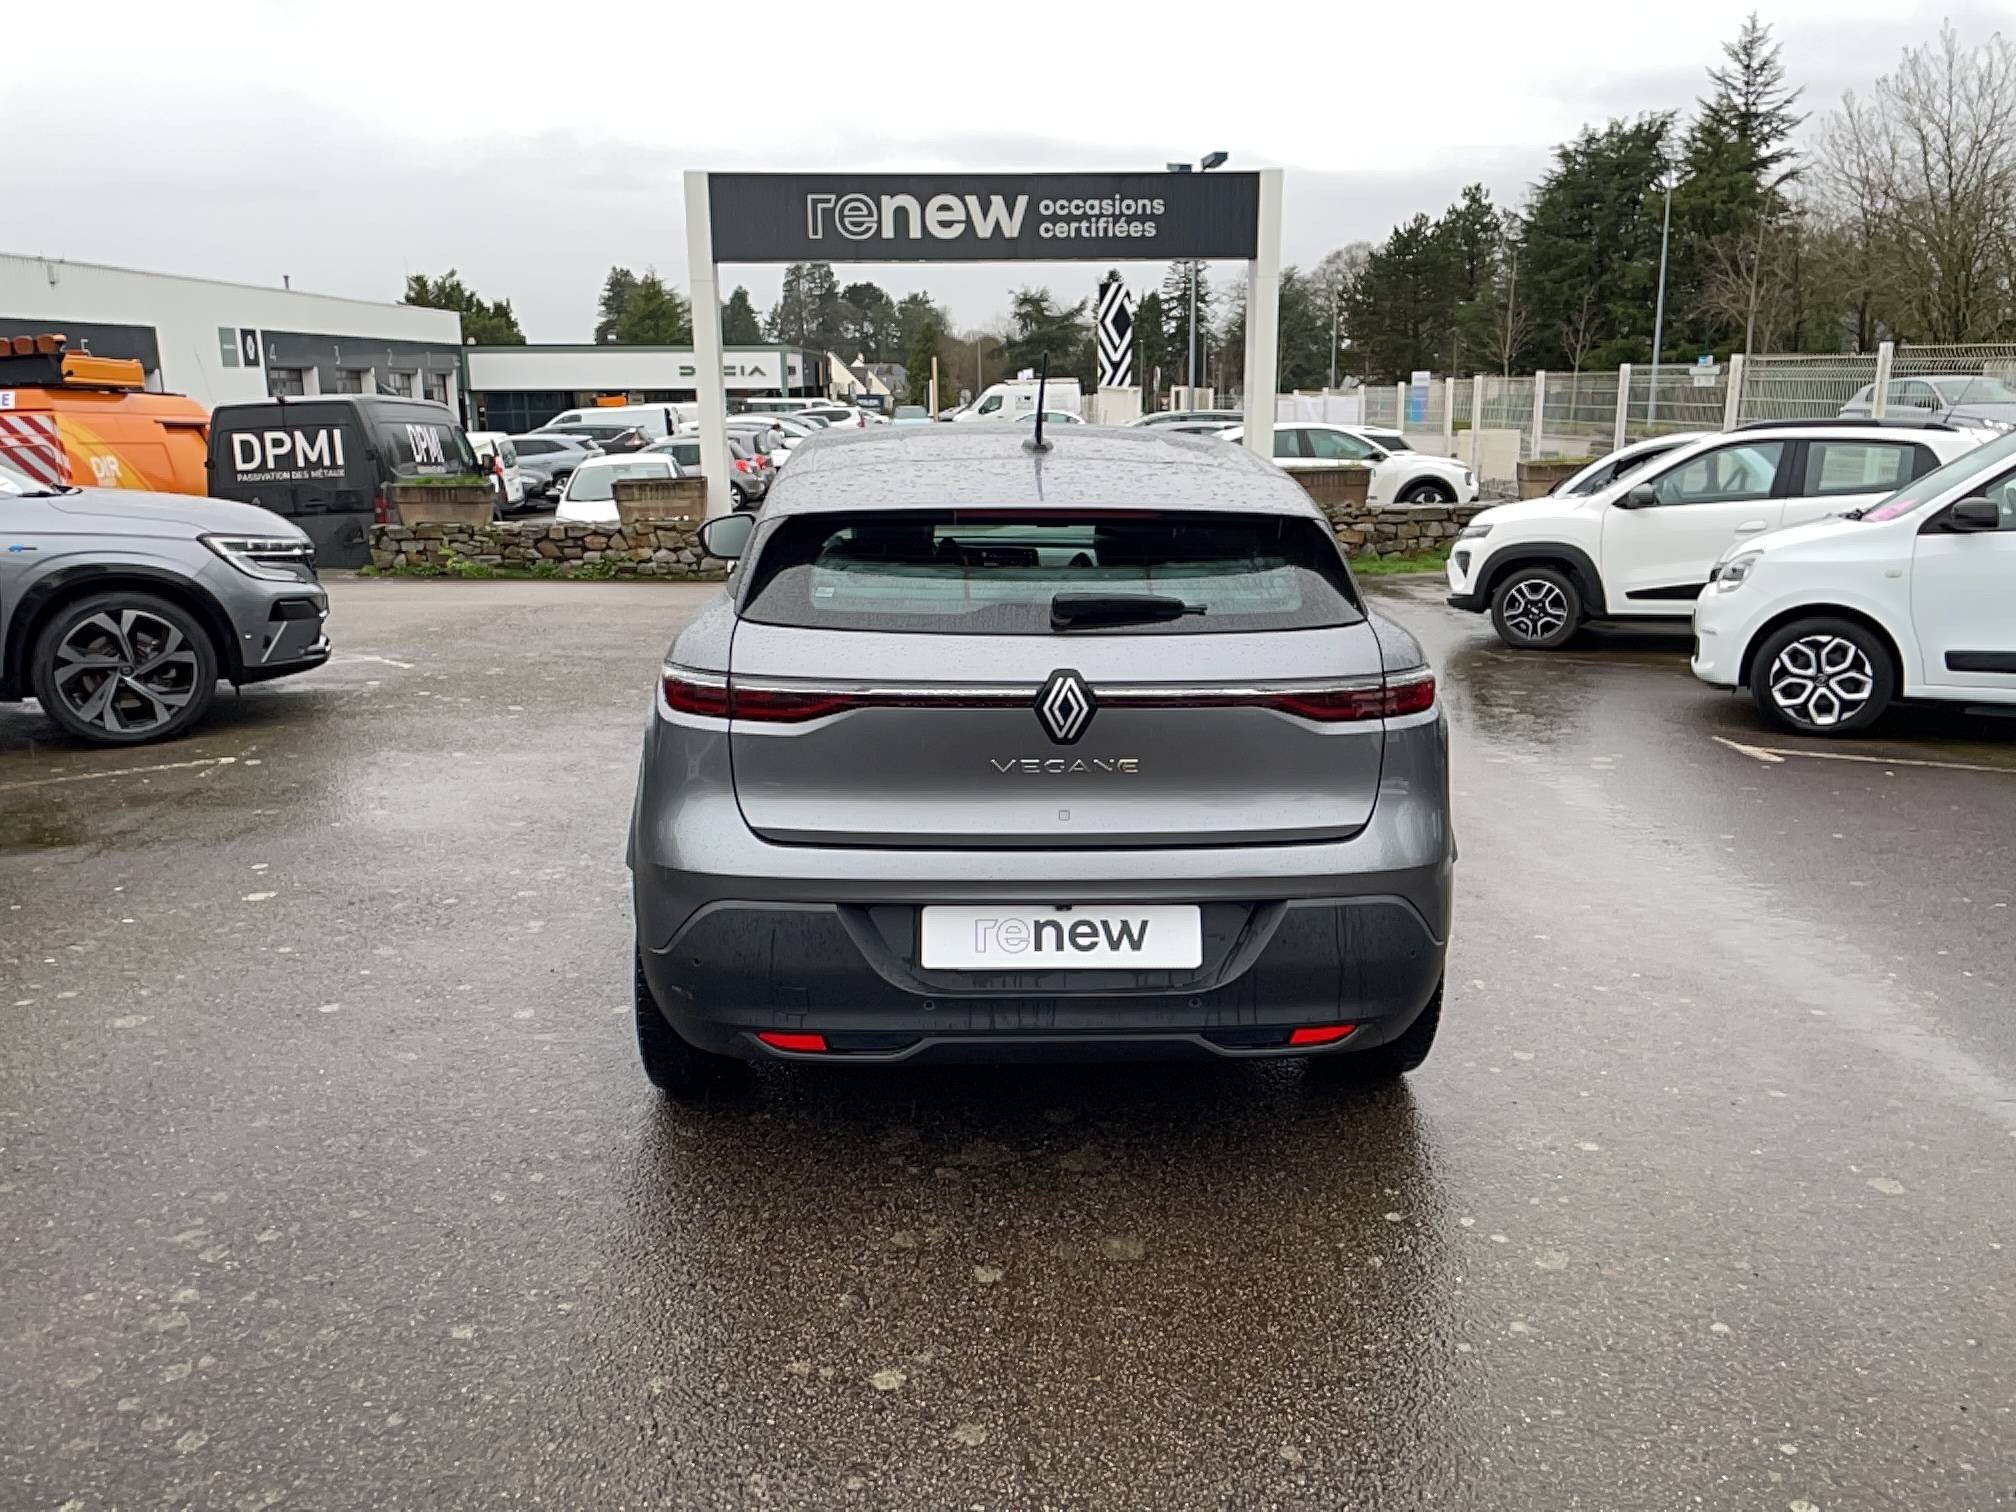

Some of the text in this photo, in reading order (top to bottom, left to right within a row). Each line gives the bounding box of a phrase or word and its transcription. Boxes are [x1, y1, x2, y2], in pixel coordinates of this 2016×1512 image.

[1038, 193, 1166, 215] occasions
[806, 193, 1030, 239] renew
[1038, 216, 1158, 238] certifiées
[269, 343, 278, 362] 4
[678, 365, 768, 377] DCIA
[231, 428, 345, 472] DPMI
[405, 423, 446, 463] DPMI
[291, 470, 310, 480] DES
[974, 917, 1149, 954] renew
